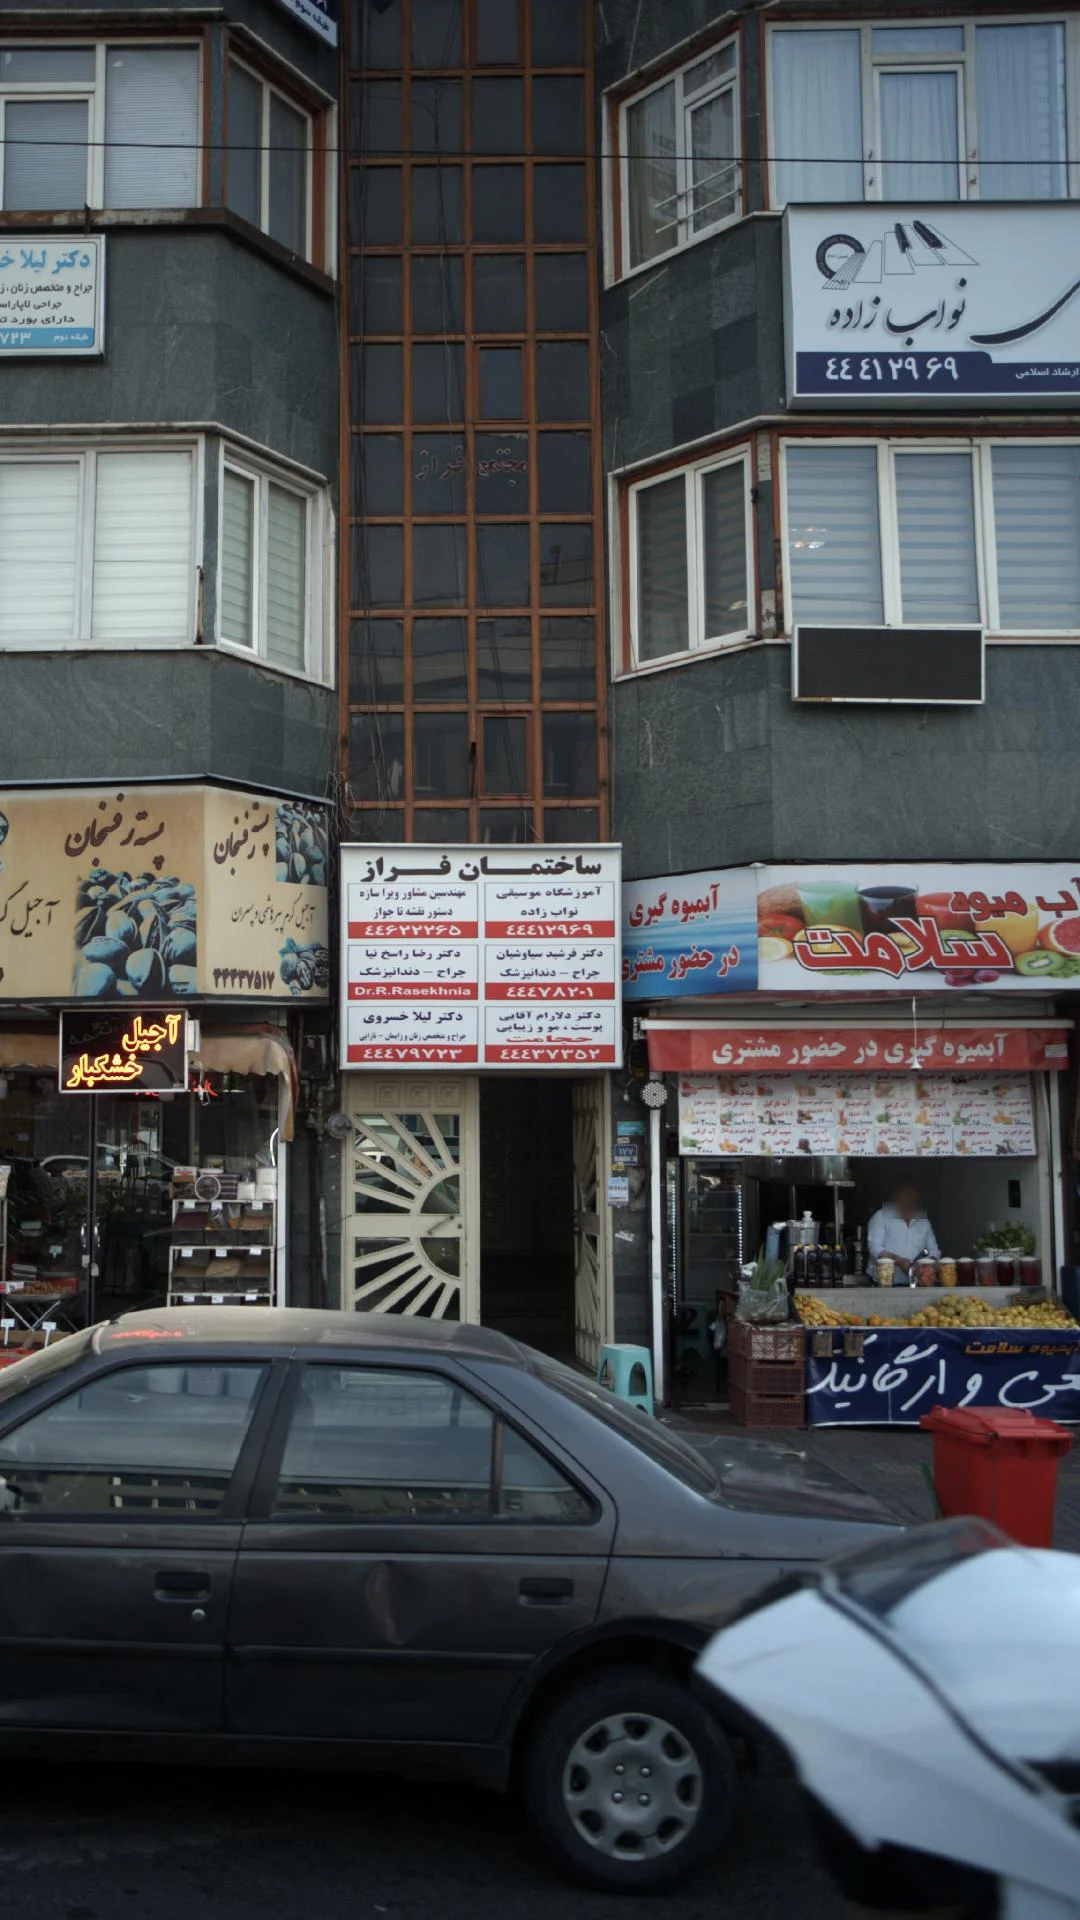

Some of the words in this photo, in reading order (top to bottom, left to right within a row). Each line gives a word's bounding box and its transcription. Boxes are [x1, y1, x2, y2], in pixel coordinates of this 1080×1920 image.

[20, 248, 47, 273] لیلا
[52, 249, 90, 275] دکتر
[30, 283, 64, 294] متخصص
[66, 284, 72, 295] و
[73, 283, 93, 297] جراح
[33, 300, 62, 310] جراحی
[828, 295, 882, 330] زاده
[885, 277, 967, 347] نواب
[10, 316, 38, 325] بورد
[41, 315, 75, 325] دارای
[1015, 367, 1049, 380] اسلامی
[360, 855, 452, 883] فراز
[458, 855, 602, 881] ساختمان
[402, 888, 428, 900] مشاور
[428, 889, 466, 900] مهندسین
[496, 888, 542, 900] موسیقی
[545, 886, 602, 899] آموزشگاه
[672, 882, 721, 923] آبمیوه
[949, 890, 1028, 922] میوه
[374, 906, 394, 920] جواز
[396, 906, 404, 916] تا
[405, 906, 425, 916] نقشه
[428, 907, 454, 919] دستور
[520, 907, 548, 918] زاده
[550, 906, 578, 918] نواب
[628, 891, 668, 928] گیری
[10, 898, 62, 938] آجیل
[496, 948, 543, 960] سیاوشیان
[546, 948, 577, 960] فرشید
[580, 948, 604, 960] دکتر
[792, 916, 1015, 980] سلامت
[365, 949, 378, 960] نیا
[380, 949, 409, 960] راسخ
[412, 949, 433, 960] رضا
[436, 949, 461, 960] دکتر
[667, 944, 714, 980] حضور
[716, 944, 740, 978] در
[359, 967, 420, 979] دندانپزشک
[436, 967, 467, 979] جراح
[500, 968, 556, 980] دندانپزشک
[572, 968, 600, 980] جراح
[354, 986, 472, 996] Dr.R.Rasekhnia
[363, 1011, 409, 1024] خسروی
[412, 1011, 432, 1024] لیلا
[436, 1011, 463, 1024] دکتر
[498, 1010, 534, 1021] آقایی
[536, 1011, 572, 1021] دلارام
[576, 1011, 602, 1021] دکتر
[120, 1014, 182, 1052] آجیل
[496, 1023, 534, 1033] زیبایی
[546, 1024, 560, 1033] مو
[506, 1034, 593, 1045] حجامت
[712, 1036, 782, 1065] مشتری
[786, 1036, 848, 1064] حضور
[852, 1040, 878, 1064] در
[884, 1036, 937, 1064] گیری
[943, 1032, 1008, 1063] آبمیوه
[66, 1052, 144, 1088] خشکبار
[964, 1341, 1024, 1355] سلامت
